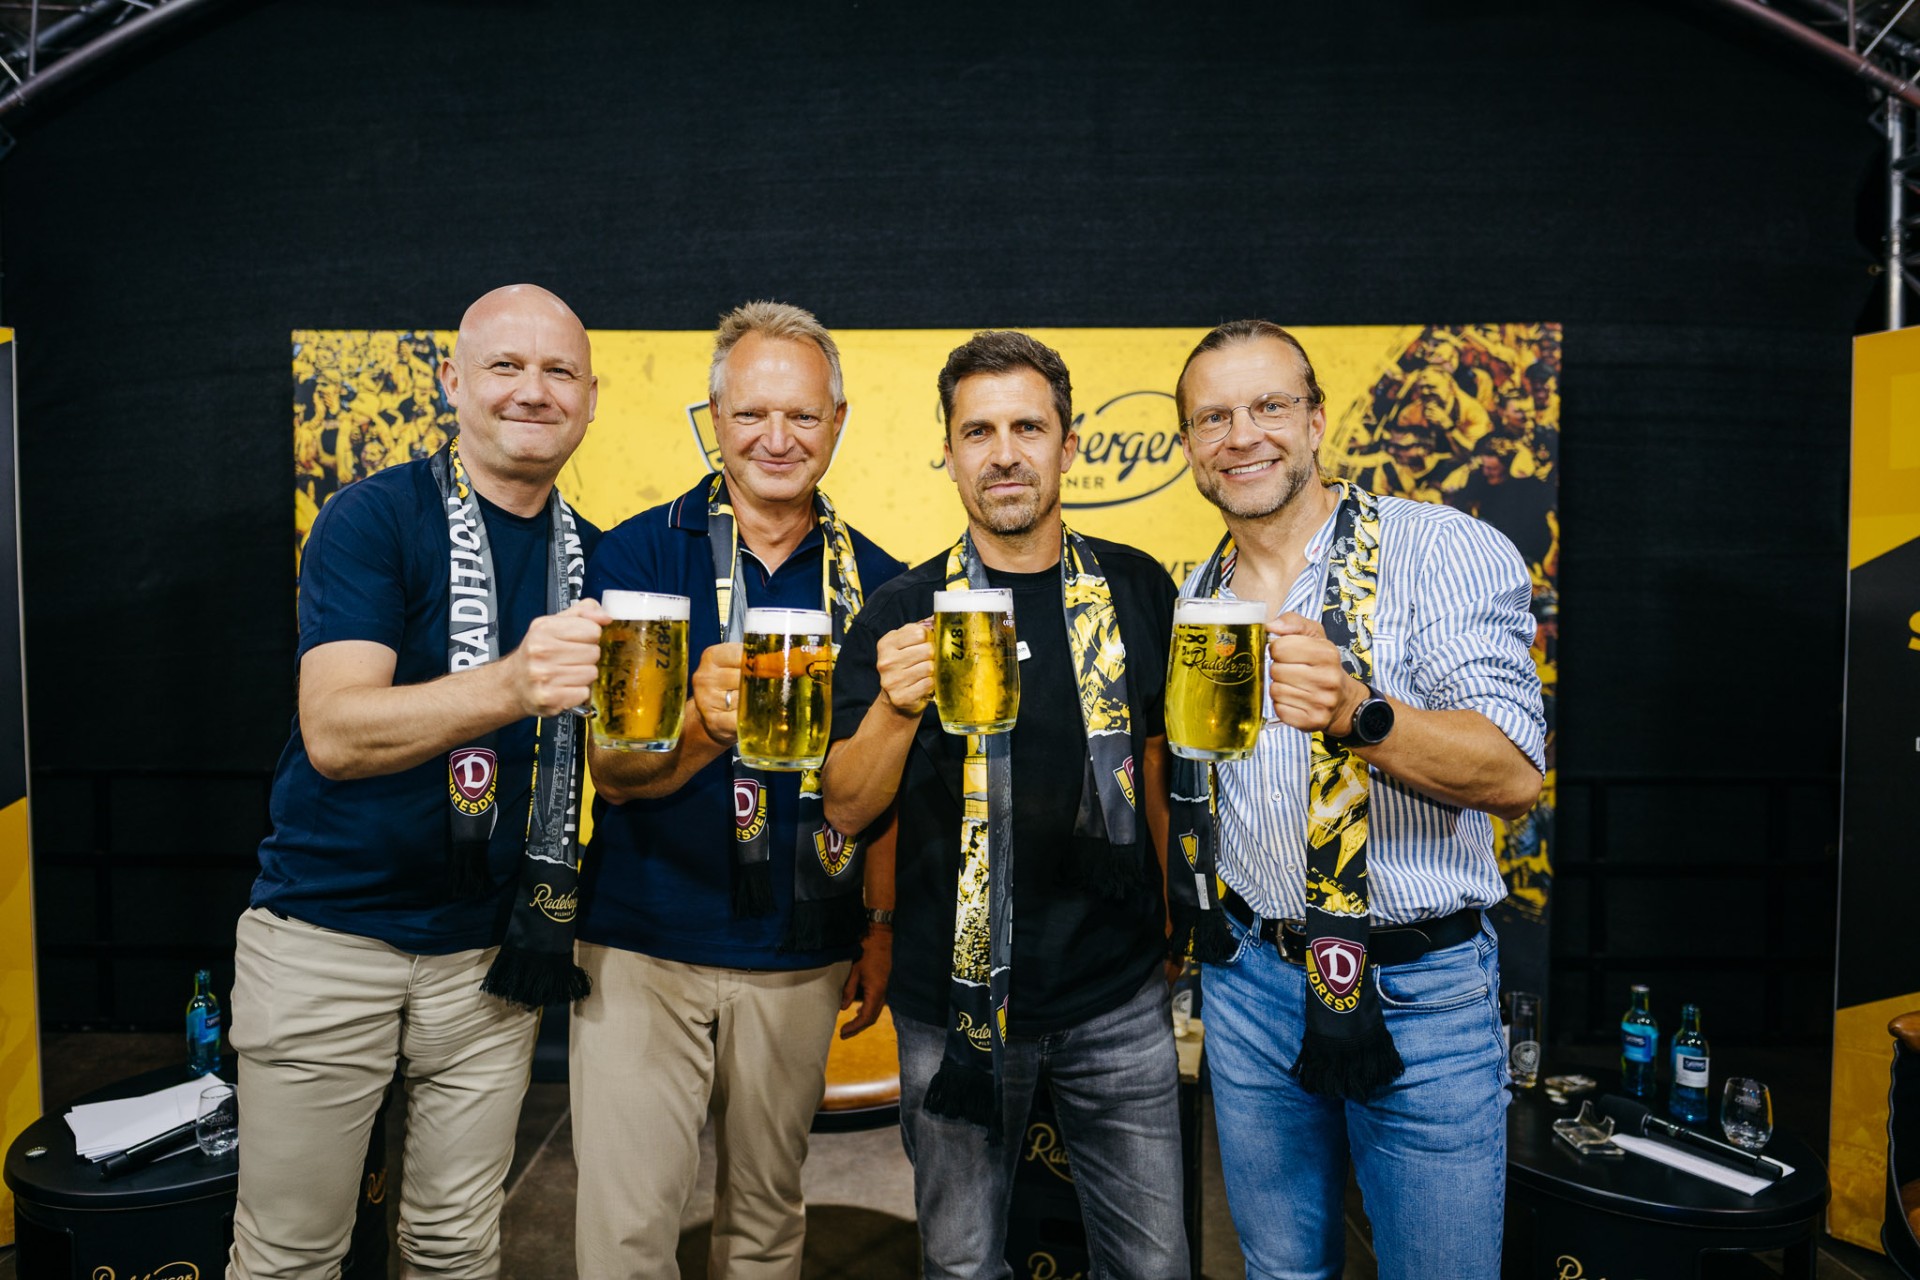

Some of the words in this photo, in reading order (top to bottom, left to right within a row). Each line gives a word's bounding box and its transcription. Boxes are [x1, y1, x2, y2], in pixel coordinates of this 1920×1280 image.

[448, 497, 489, 673] RADITION
[449, 782, 497, 813] DRESDEN
[736, 808, 766, 840] ESDEN
[1308, 971, 1363, 1011] DRESDE
